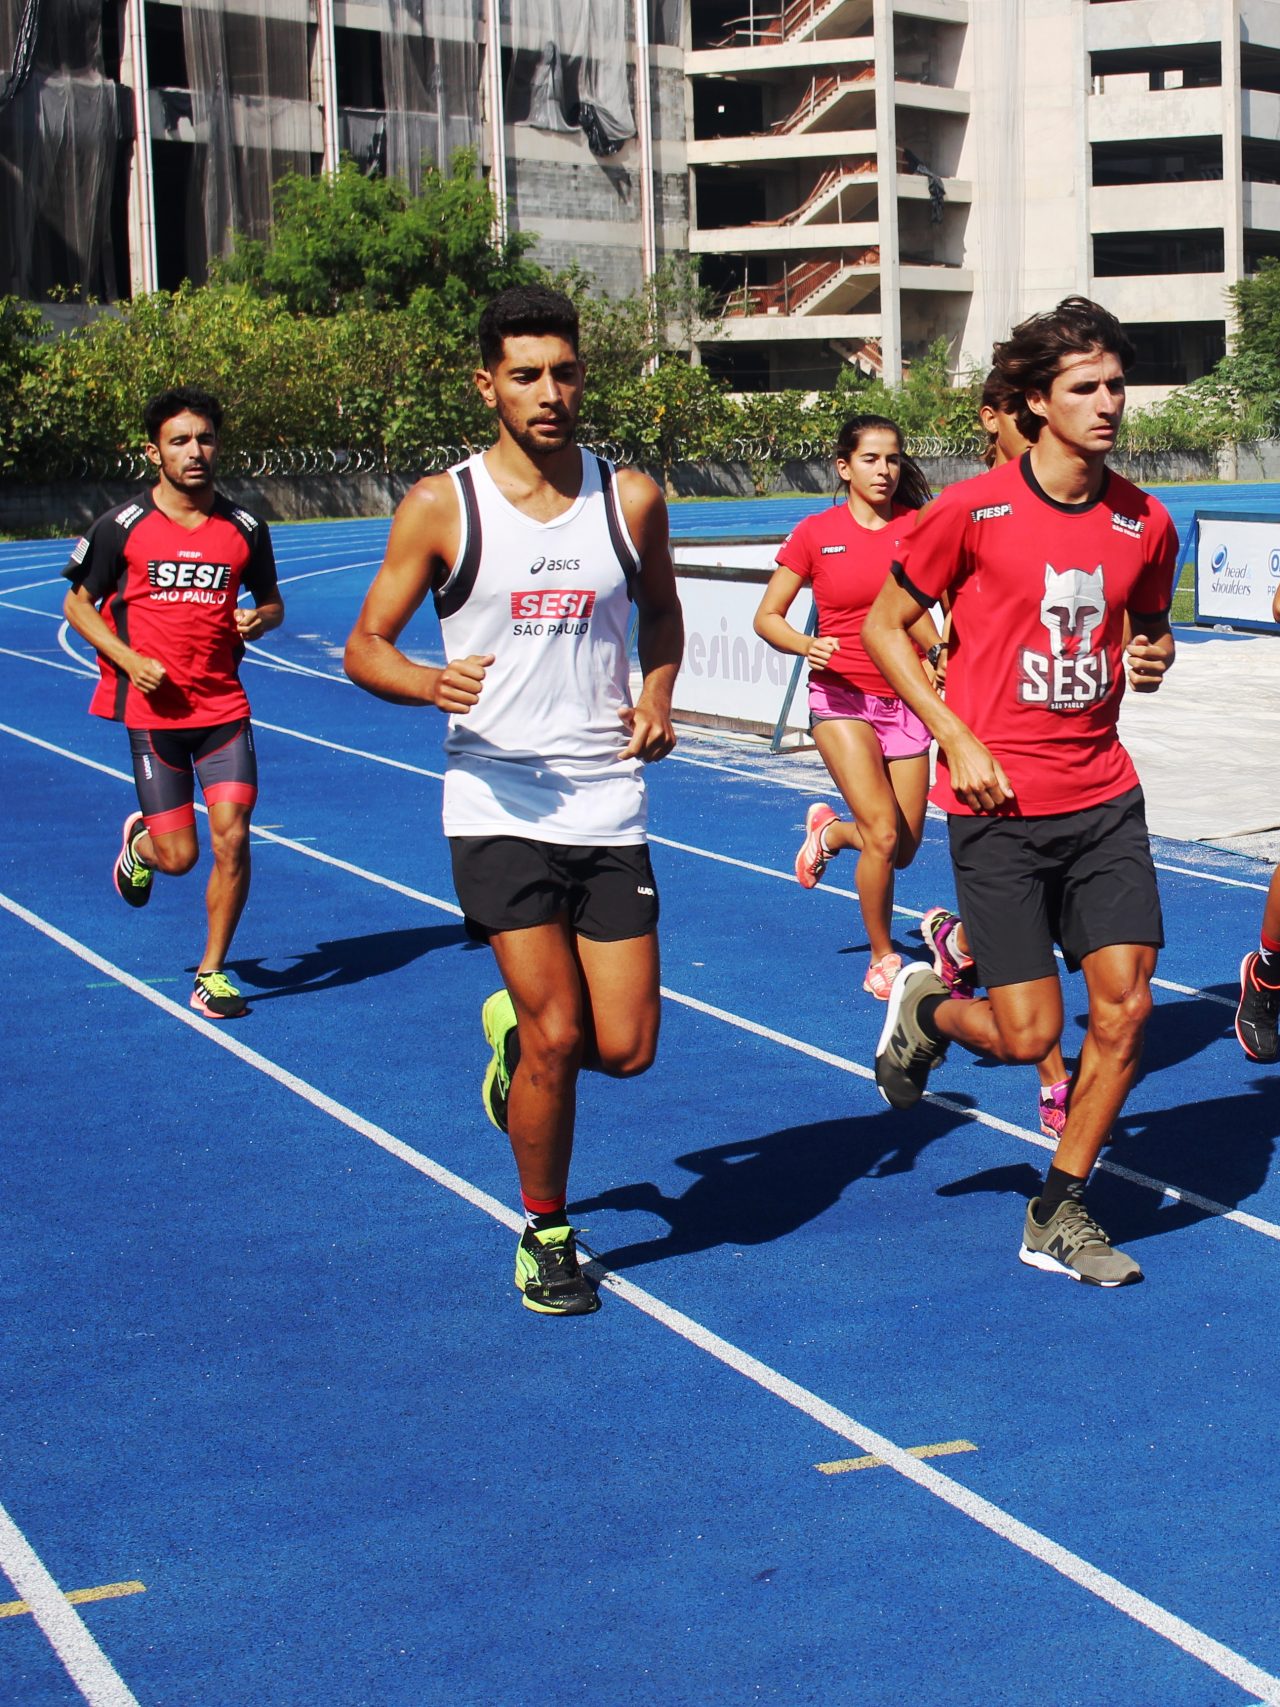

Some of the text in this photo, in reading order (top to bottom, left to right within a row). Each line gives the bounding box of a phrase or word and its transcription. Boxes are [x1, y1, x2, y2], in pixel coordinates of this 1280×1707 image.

[976, 503, 1010, 521] FIESP
[1112, 512, 1141, 532] SESI
[156, 563, 225, 588] SESI
[1222, 562, 1247, 578] head
[1211, 578, 1251, 596] shoulders
[182, 591, 227, 605] PAULO
[519, 593, 589, 617] SESI
[513, 622, 589, 636] SÃO PAULO
[1022, 648, 1108, 702] SESI
